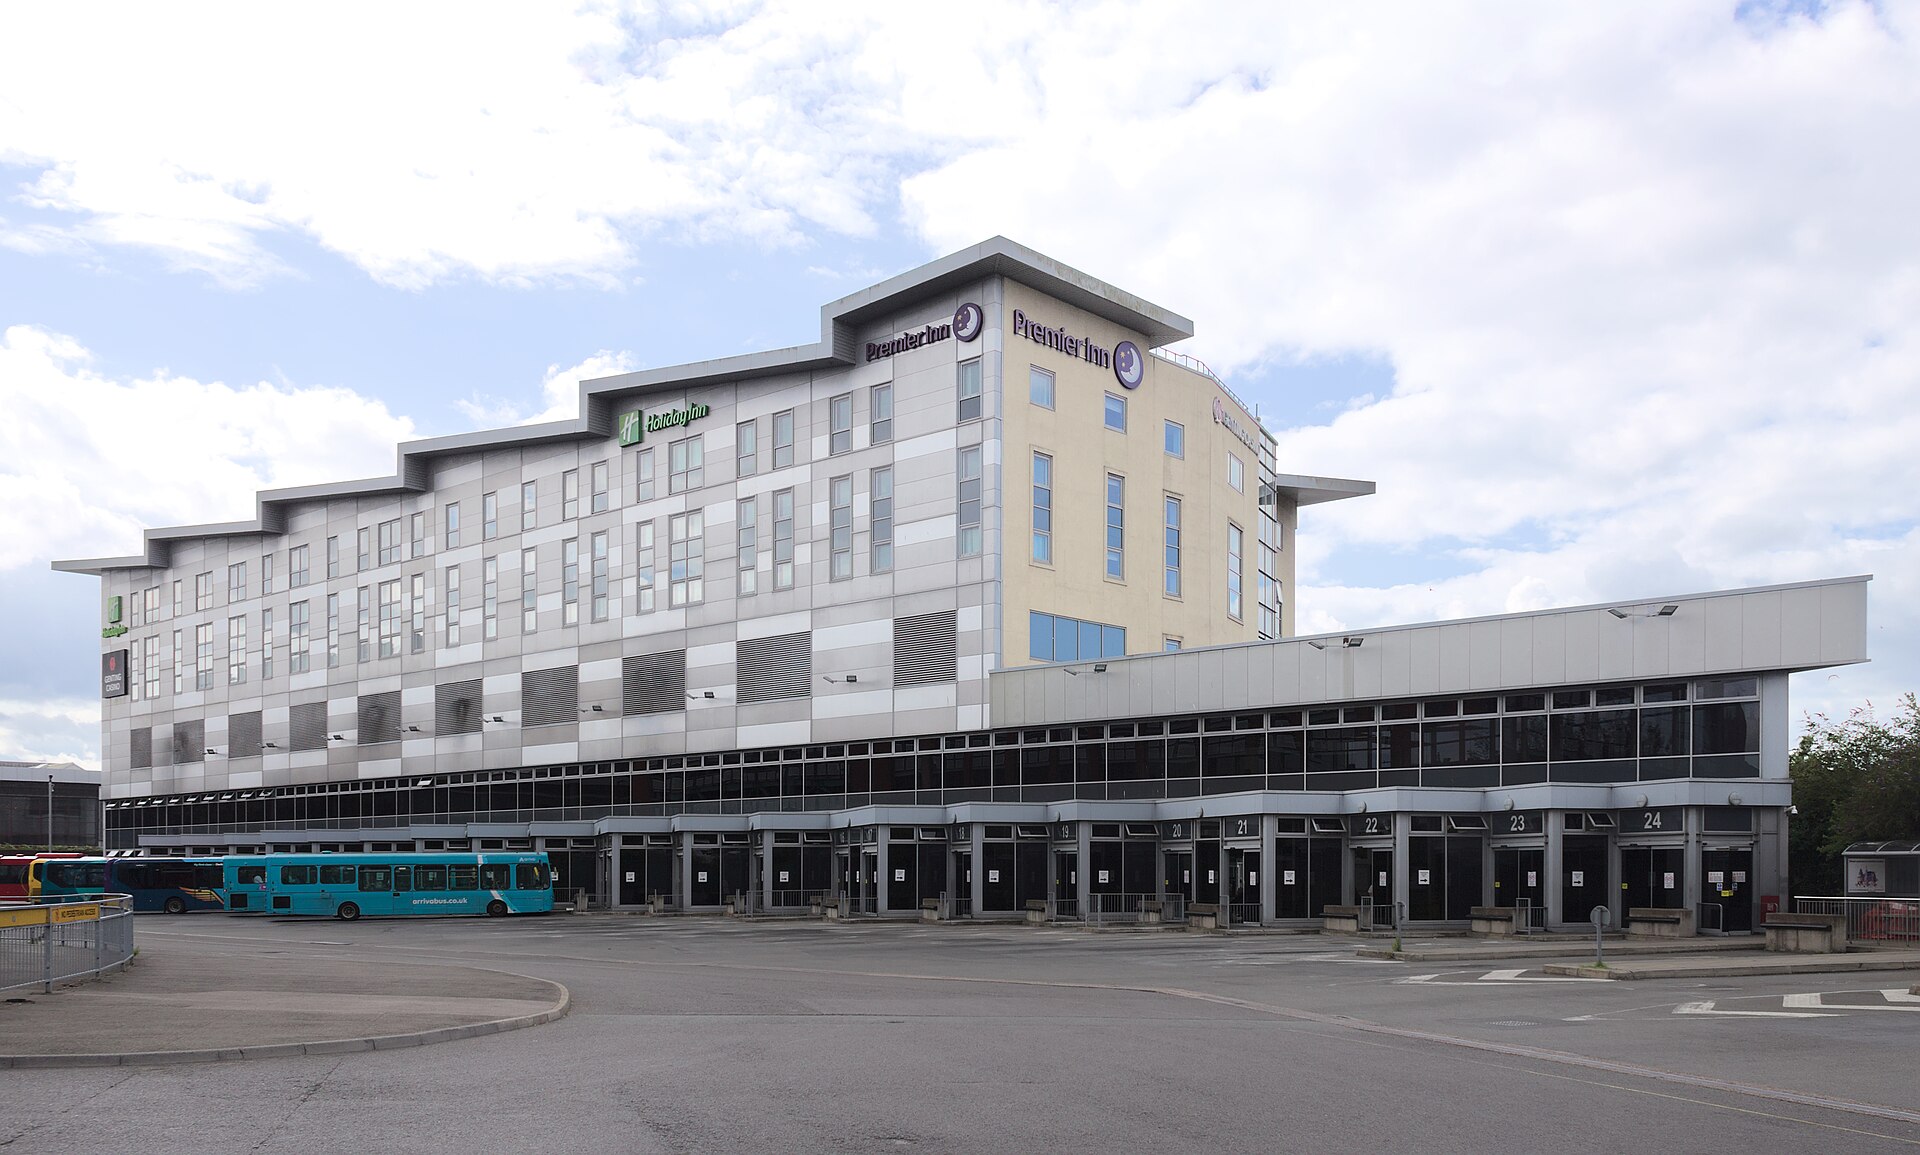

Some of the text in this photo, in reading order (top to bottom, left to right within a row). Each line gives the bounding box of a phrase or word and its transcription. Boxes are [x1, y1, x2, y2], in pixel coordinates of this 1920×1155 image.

[866, 324, 950, 362] Premier Inn
[1014, 309, 1110, 369] Premier Inn
[645, 402, 709, 432] Holiday Inn
[1237, 819, 1248, 835] 21
[1365, 817, 1378, 833] 22
[1510, 814, 1525, 832] 23
[1643, 811, 1662, 829] 24
[1061, 825, 1069, 839] 19
[1172, 823, 1182, 838] 20
[412, 897, 468, 905] arrivabus.co.uk
